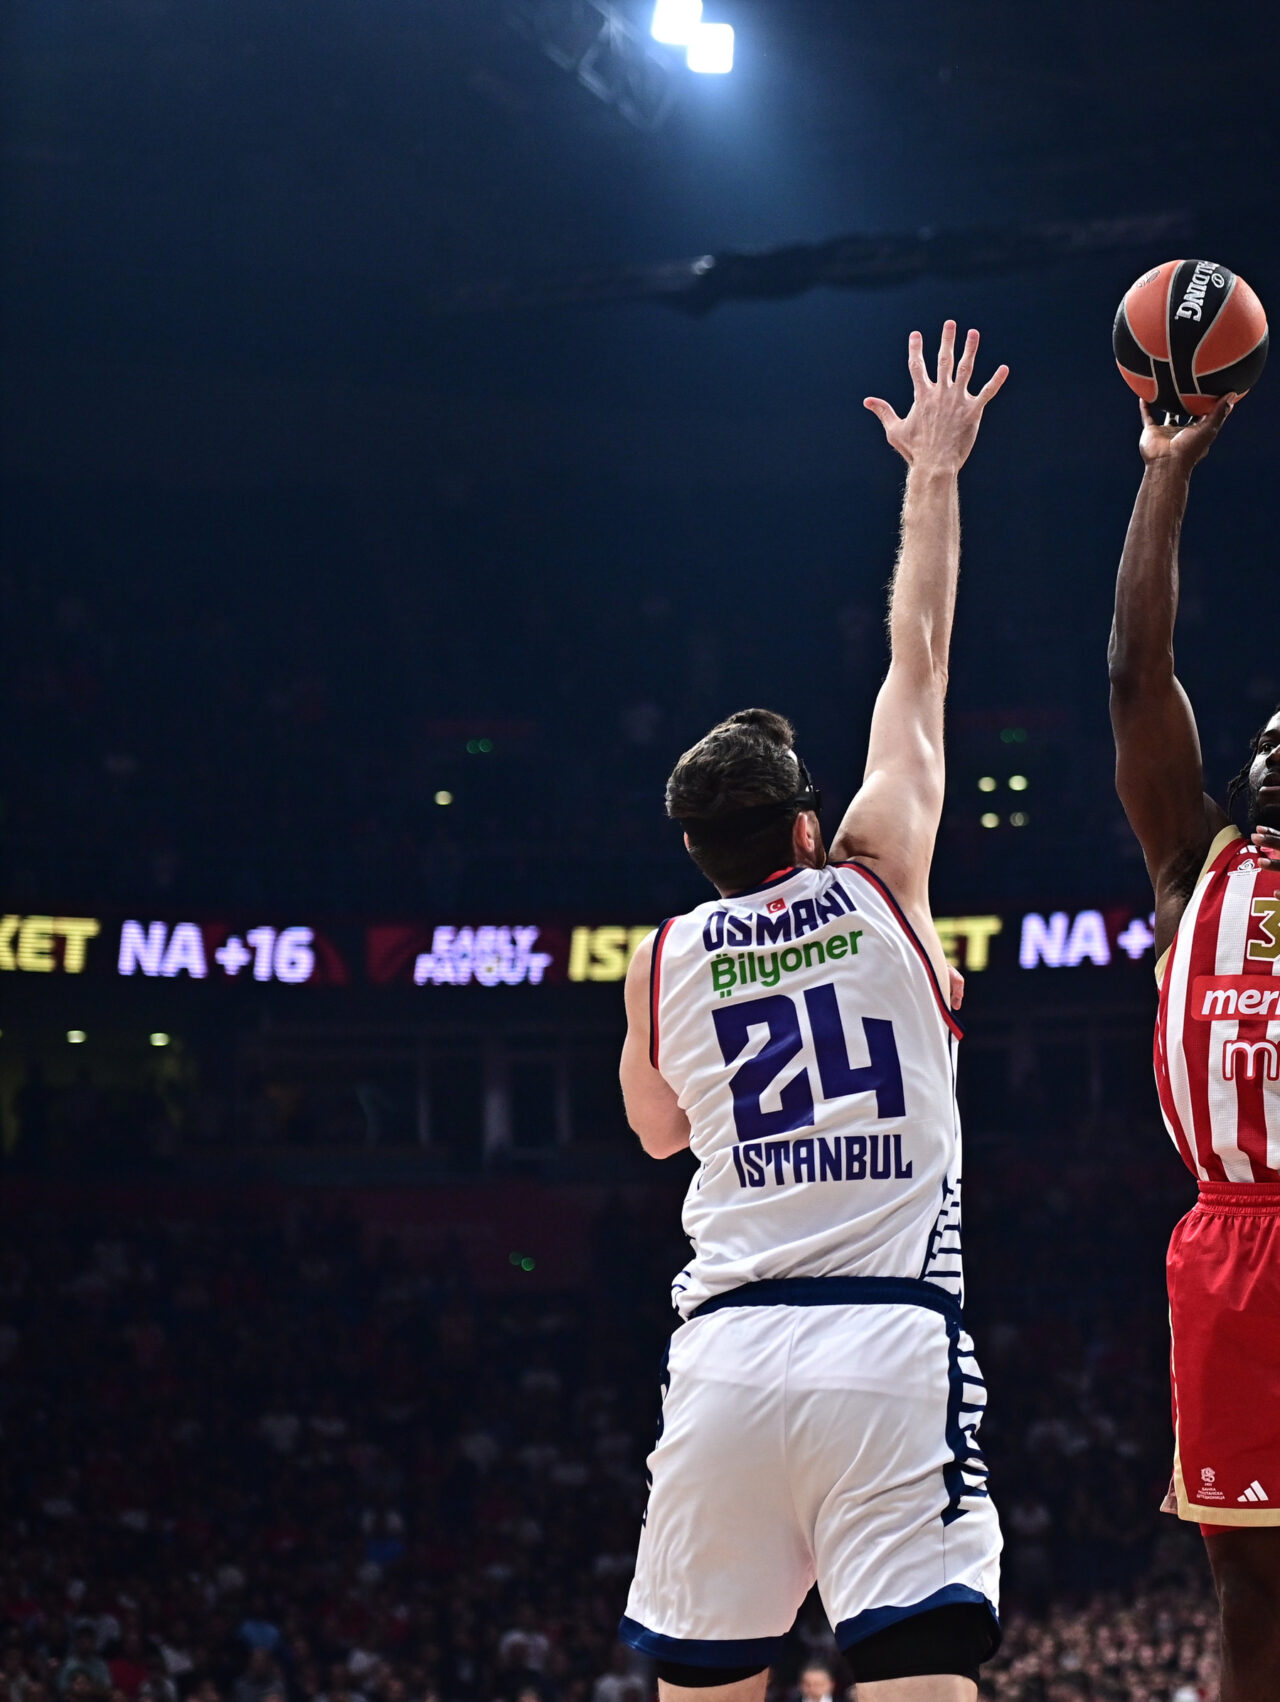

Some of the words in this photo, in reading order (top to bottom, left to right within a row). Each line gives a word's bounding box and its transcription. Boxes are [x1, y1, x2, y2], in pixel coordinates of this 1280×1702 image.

[702, 880, 857, 952] OSMANI
[1018, 910, 1111, 970] NA
[117, 919, 208, 979] NA
[215, 925, 315, 984] +16
[710, 930, 863, 998] Bilyoner
[711, 982, 907, 1142] 24
[732, 1133, 913, 1189] ISTANBUL
